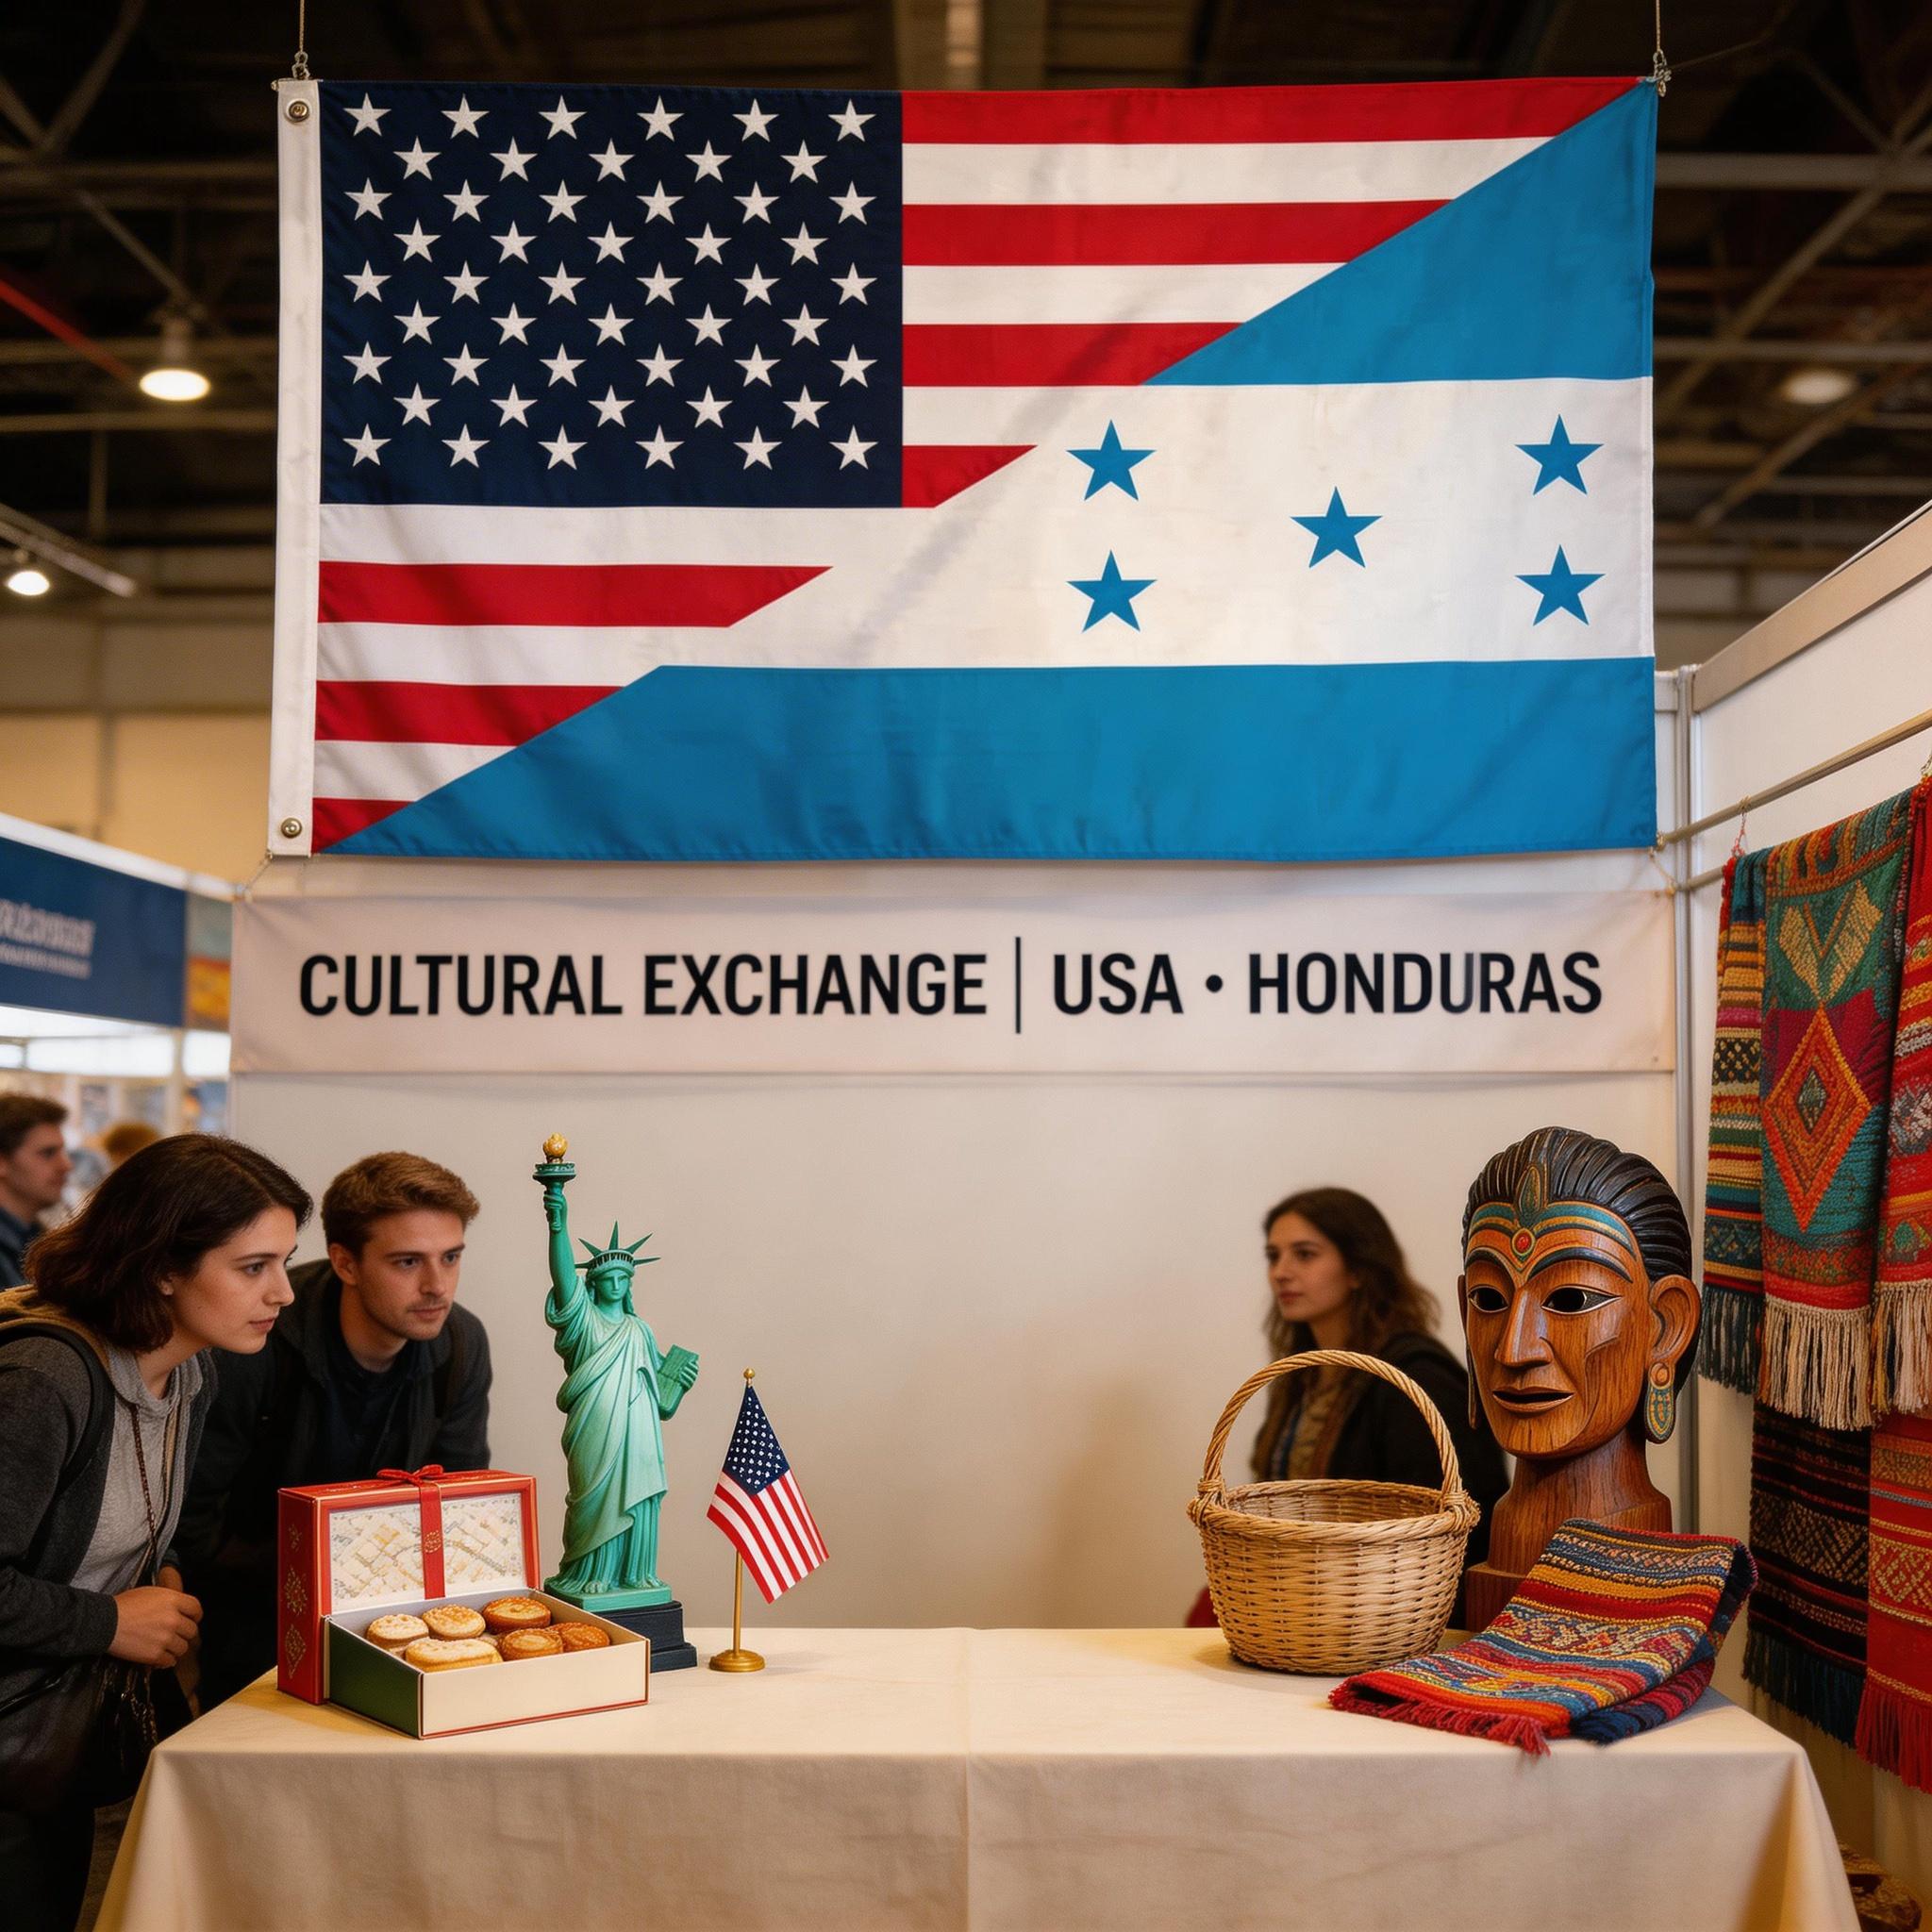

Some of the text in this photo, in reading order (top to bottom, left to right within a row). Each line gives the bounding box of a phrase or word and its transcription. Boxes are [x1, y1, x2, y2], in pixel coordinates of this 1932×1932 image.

[299, 951, 1603, 1018] CULTURAL EXCHANGE USA HONDURAS
